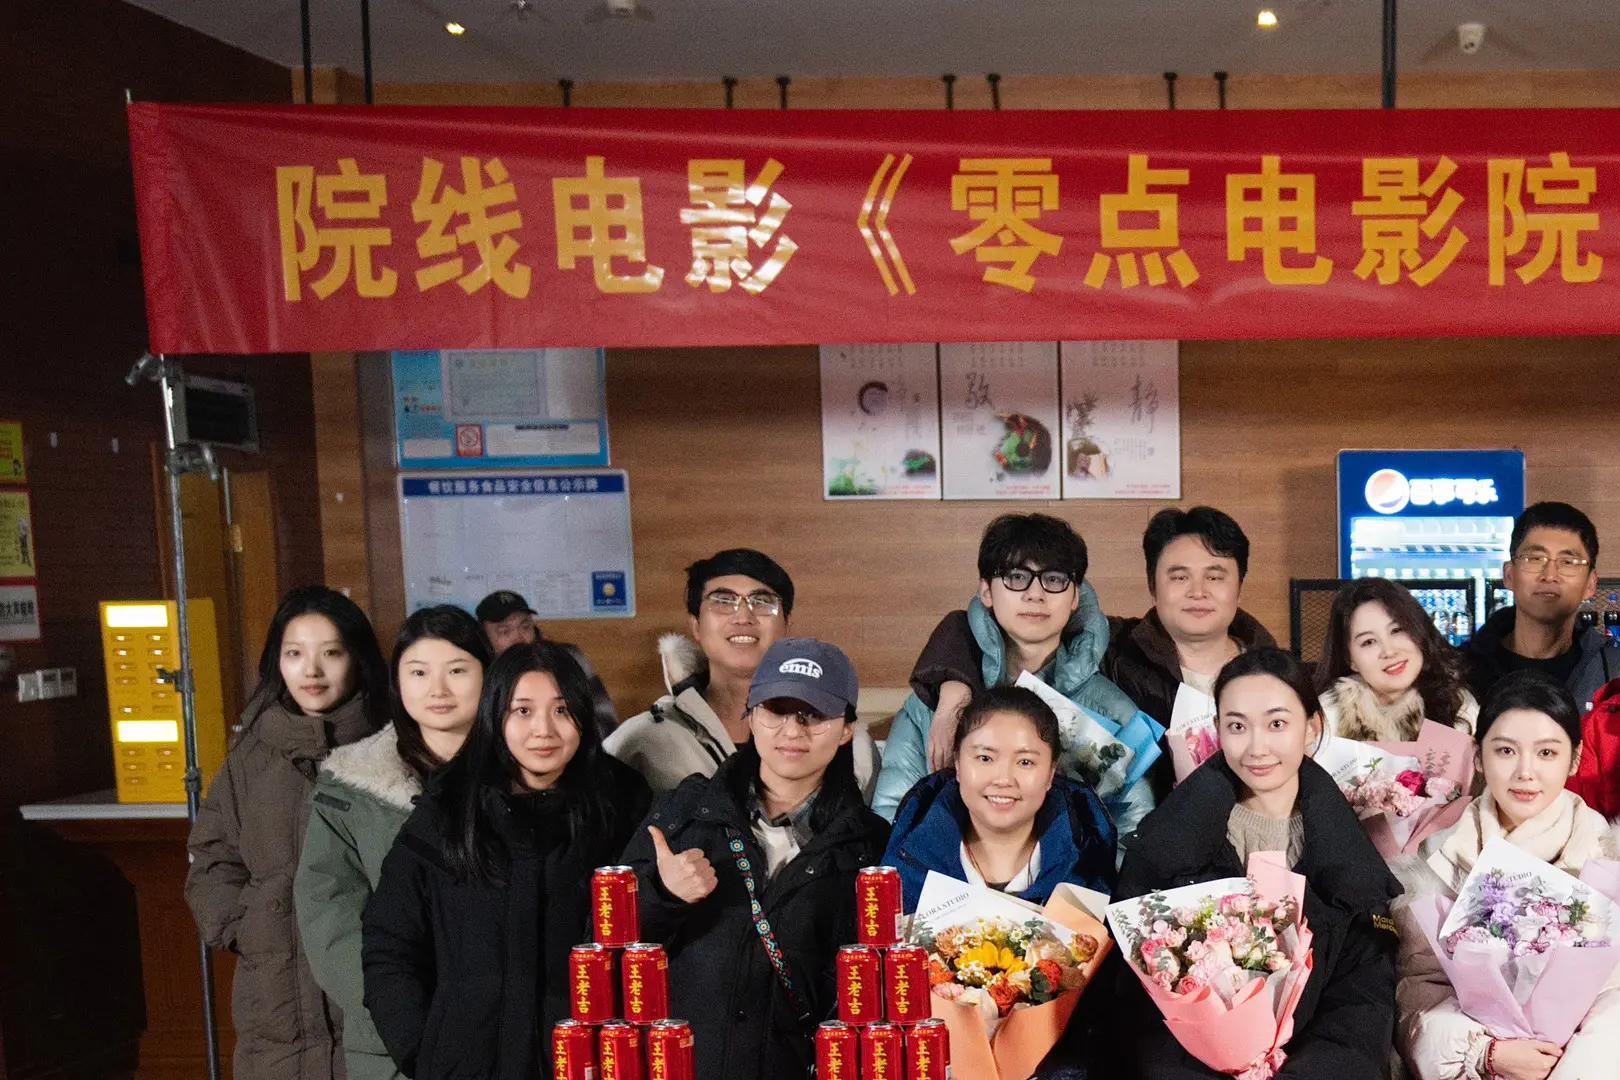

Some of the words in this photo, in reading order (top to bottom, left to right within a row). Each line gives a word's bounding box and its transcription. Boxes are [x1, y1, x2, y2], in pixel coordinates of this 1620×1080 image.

[778, 660, 824, 679] emis
[599, 887, 613, 937] 王老吉
[865, 887, 879, 937] 王老吉
[941, 892, 970, 909] STUDIO
[576, 963, 591, 1013] 王老吉
[630, 964, 643, 1014] 王老吉
[848, 965, 862, 1015] 王老吉
[895, 963, 910, 1013] 王老吉
